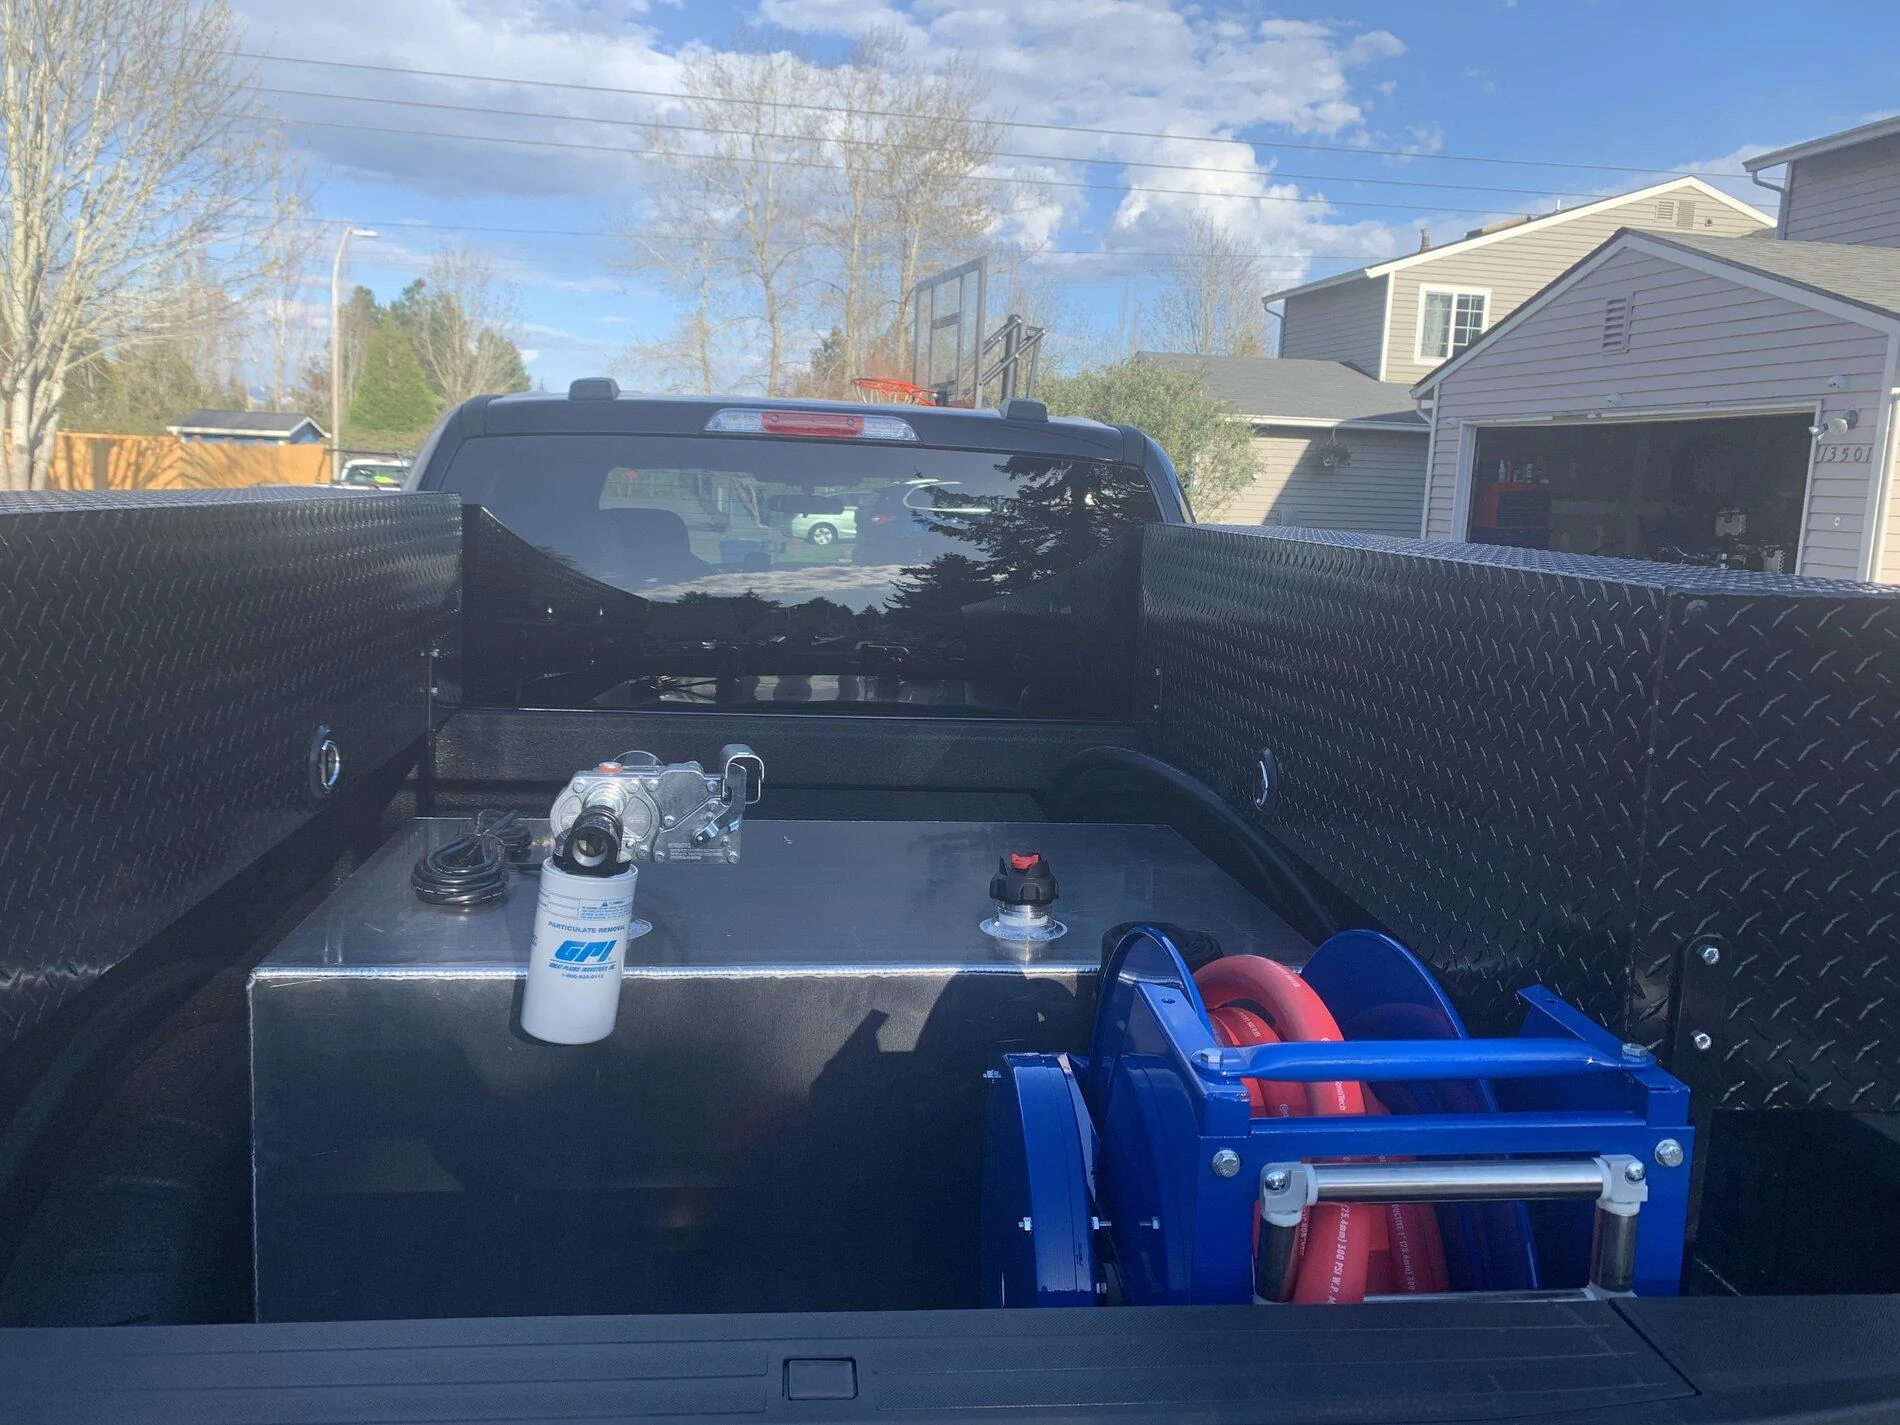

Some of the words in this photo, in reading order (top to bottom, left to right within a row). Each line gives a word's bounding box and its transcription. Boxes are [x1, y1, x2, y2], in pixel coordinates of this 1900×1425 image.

[1818, 446, 1872, 463] 13501
[548, 921, 597, 933] PARTICULATE
[555, 940, 617, 962] GPI
[562, 964, 581, 972] PLAINS
[1333, 1260, 1345, 1276] PSI
